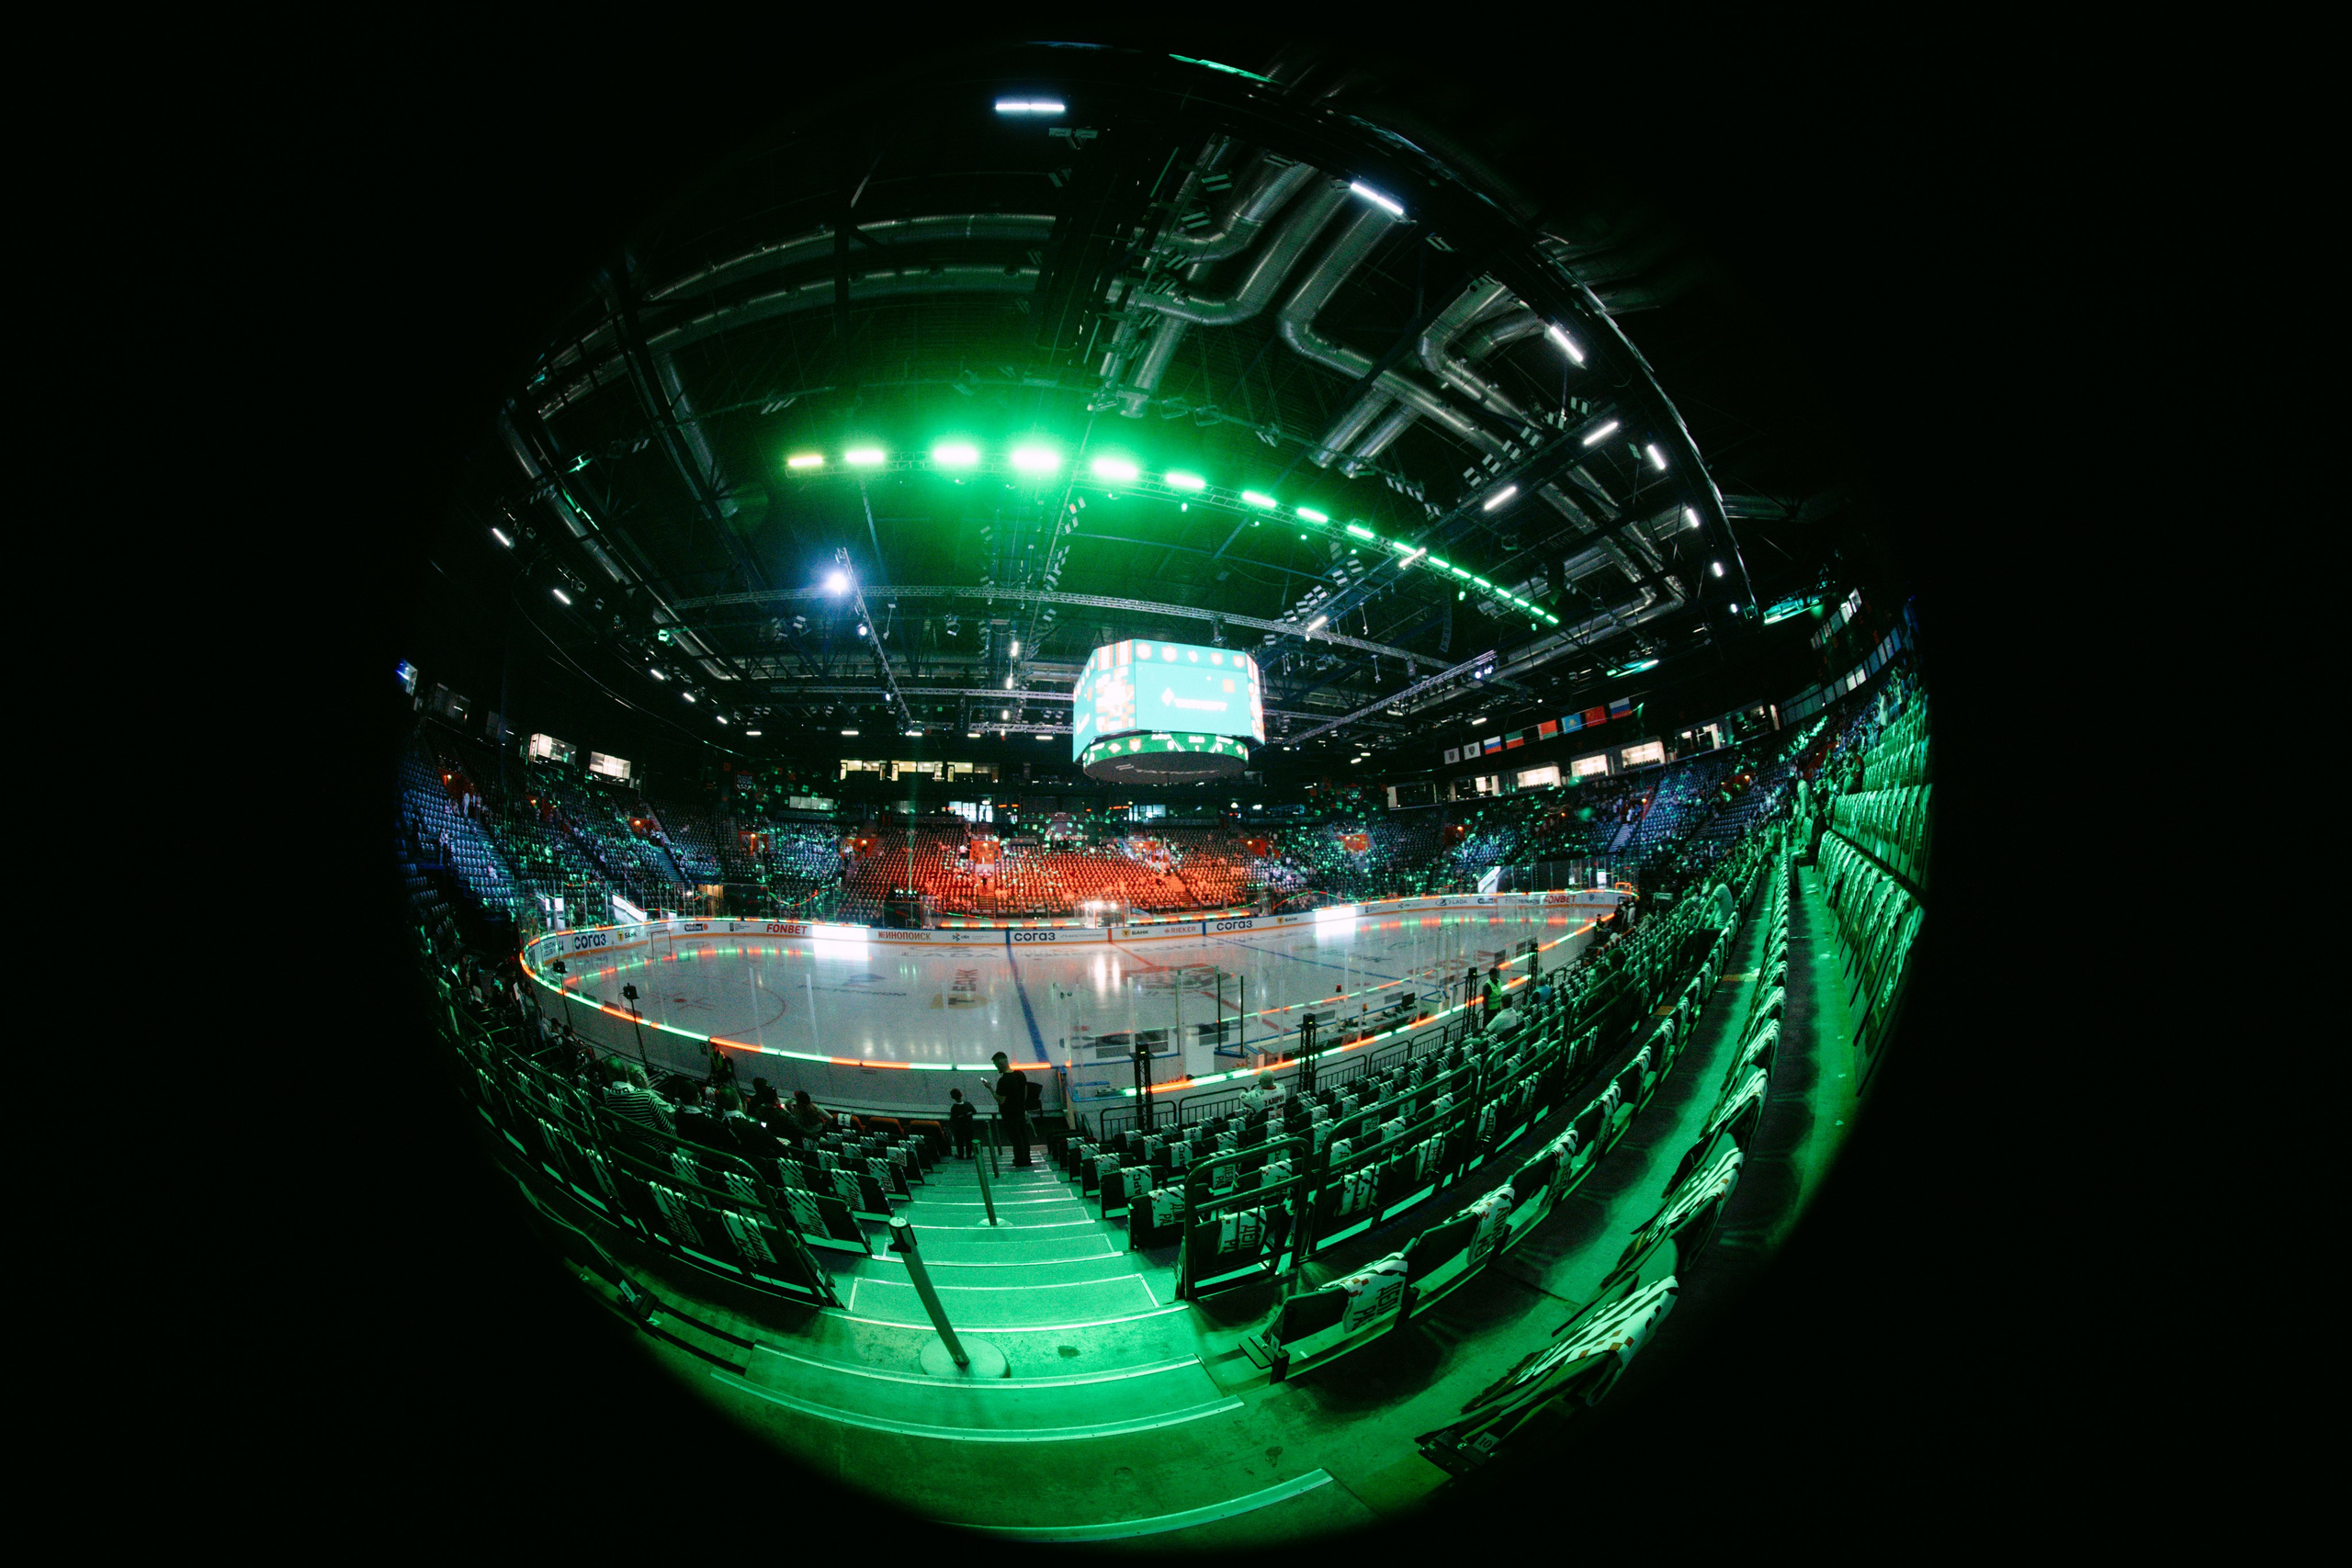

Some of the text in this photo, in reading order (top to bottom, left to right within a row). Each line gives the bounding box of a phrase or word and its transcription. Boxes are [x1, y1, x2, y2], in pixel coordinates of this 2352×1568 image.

[766, 923, 808, 934] FONBET
[1170, 926, 1197, 934] RIEKER
[1216, 920, 1253, 931] согаз
[574, 933, 607, 950] согаз
[1013, 932, 1057, 942] согаз
[1134, 1174, 1143, 1195] АРС
[1479, 1438, 1493, 1449] 10
